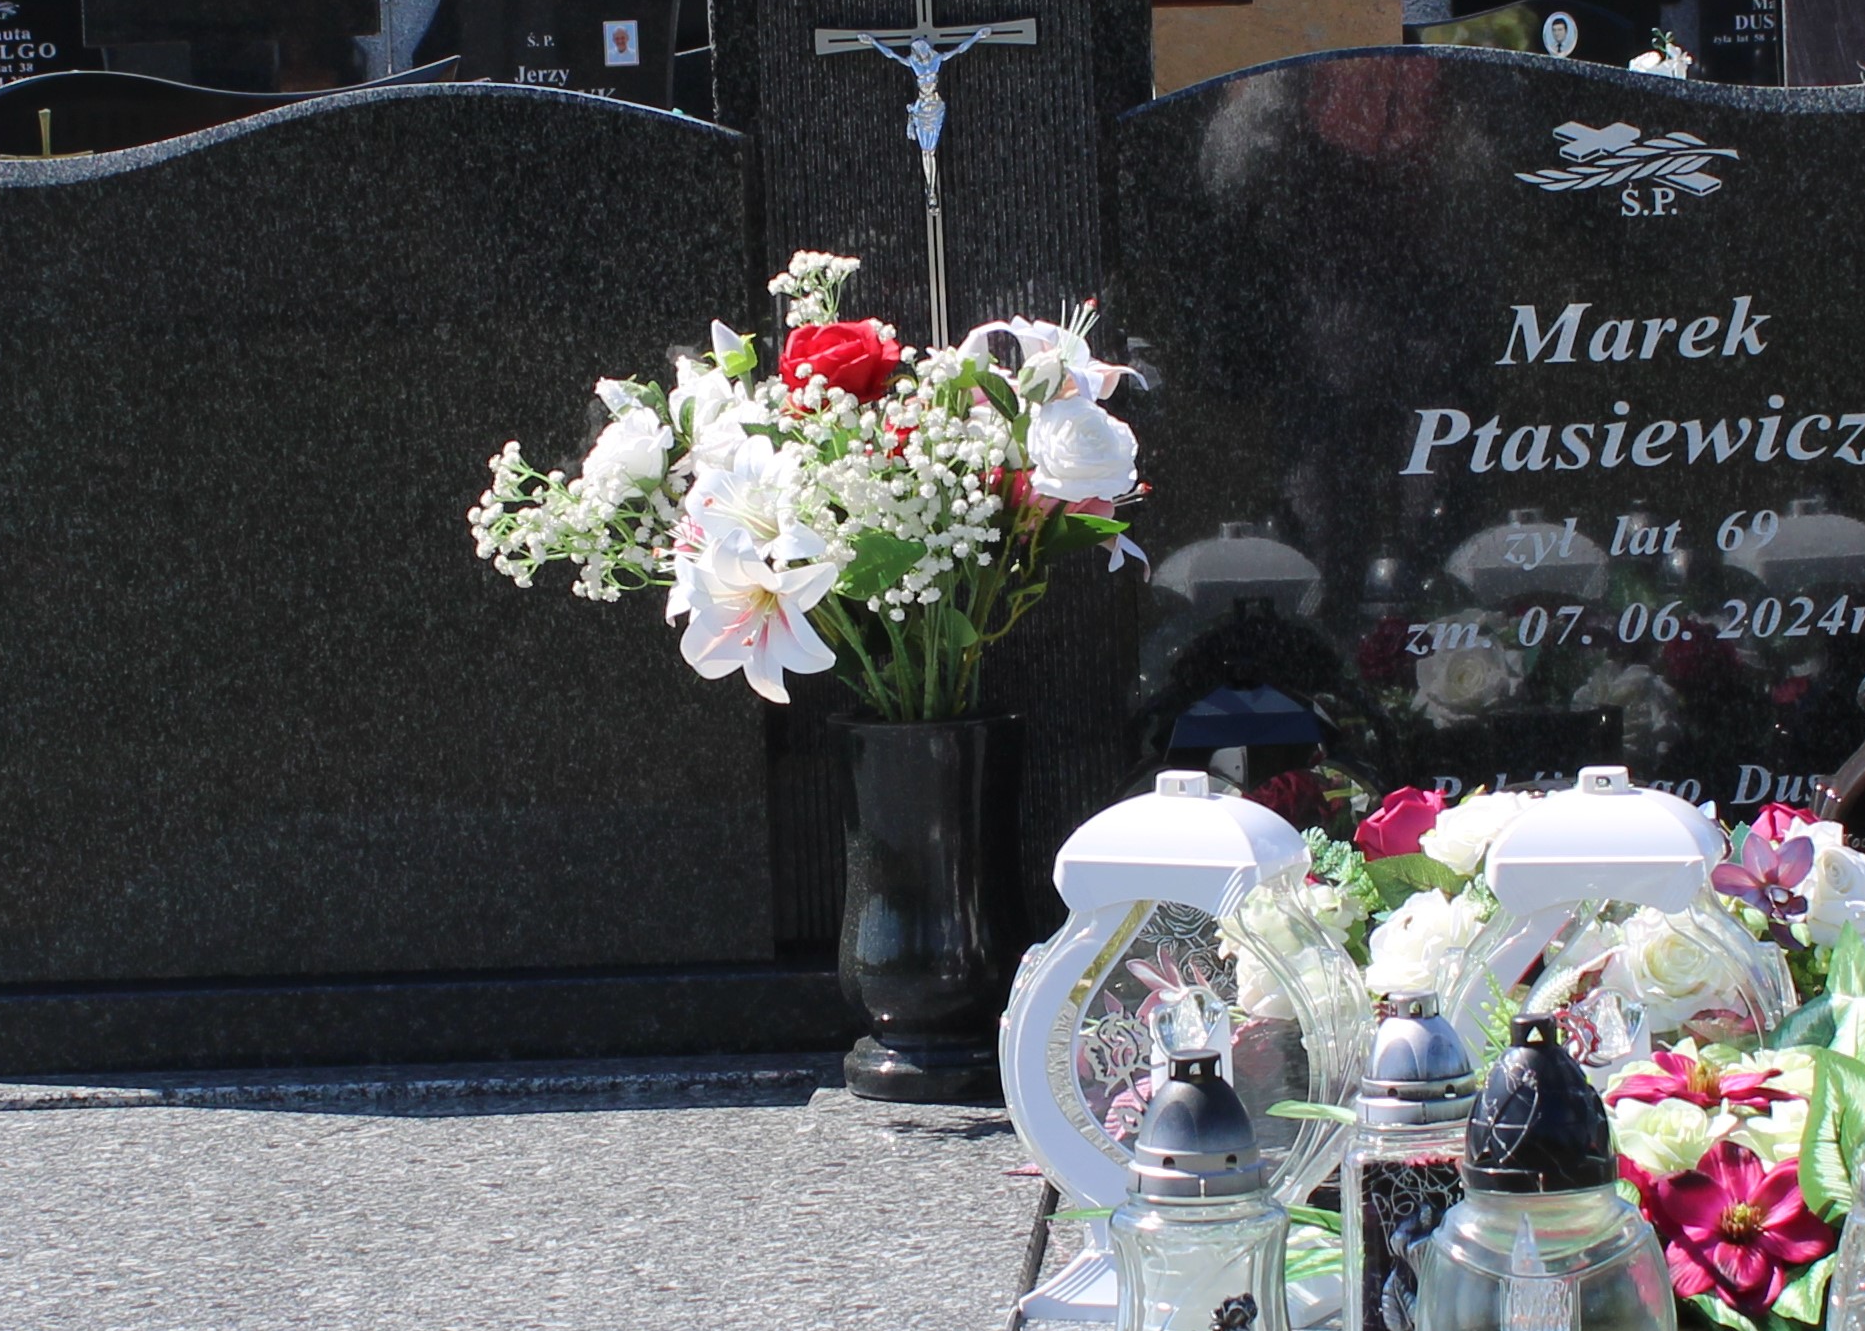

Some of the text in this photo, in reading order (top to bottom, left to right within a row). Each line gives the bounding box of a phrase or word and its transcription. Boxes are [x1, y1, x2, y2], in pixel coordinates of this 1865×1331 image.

[1735, 14, 1775, 30] DUS
[514, 66, 570, 87] Jerzy
[1621, 182, 1678, 217] Ś.P.
[1494, 295, 1772, 365] Marek
[1504, 509, 1780, 571] żył lat 69
[1406, 622, 1493, 656] zm.
[1518, 604, 1593, 648] 07.
[1618, 600, 1694, 644] 06.
[1731, 764, 1823, 807] Dus
